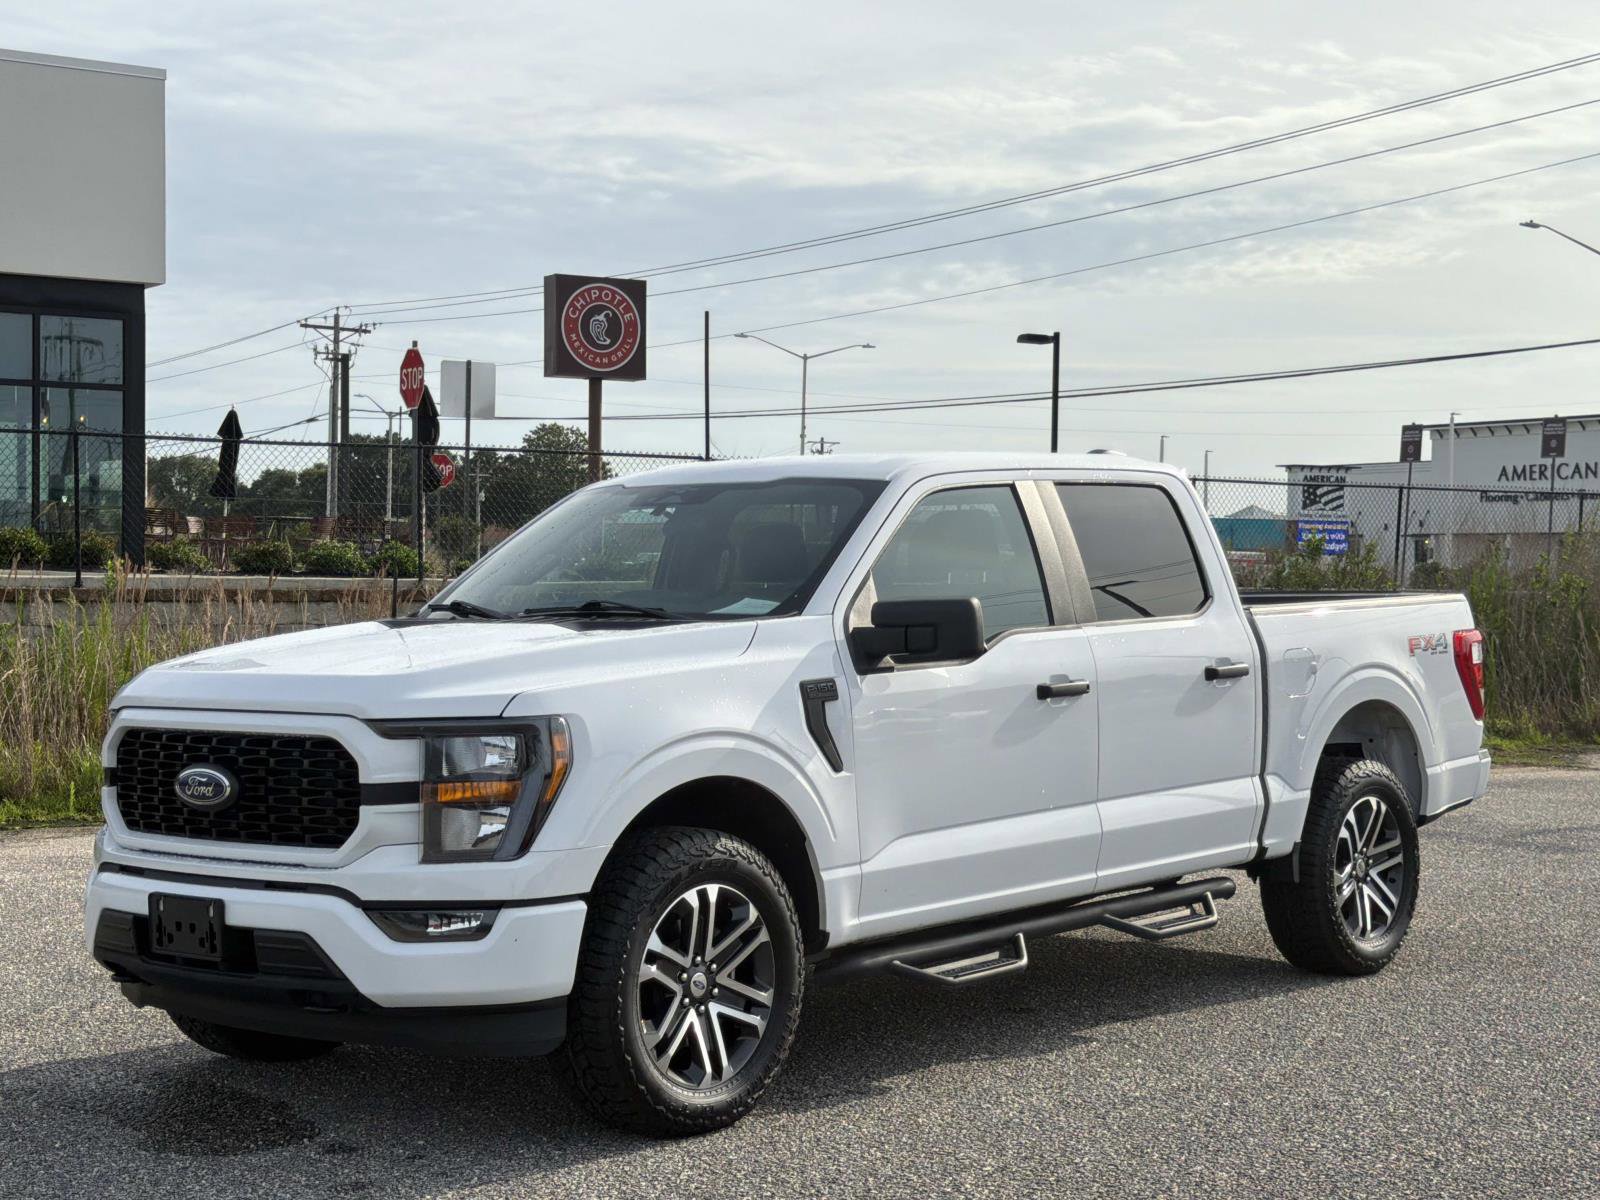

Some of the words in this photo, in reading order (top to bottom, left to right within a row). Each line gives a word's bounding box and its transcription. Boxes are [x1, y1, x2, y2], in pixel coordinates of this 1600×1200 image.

[568, 289, 635, 323] CHIPOTLE
[569, 333, 609, 364] MEXICAN
[611, 337, 633, 361] GRILL
[401, 366, 423, 390] STOP
[1302, 474, 1347, 484] AMERICAN
[1497, 461, 1598, 482] AMERCAN
[1480, 490, 1520, 504] Flooring
[1408, 632, 1448, 657] FX4
[185, 775, 215, 797] Ford
